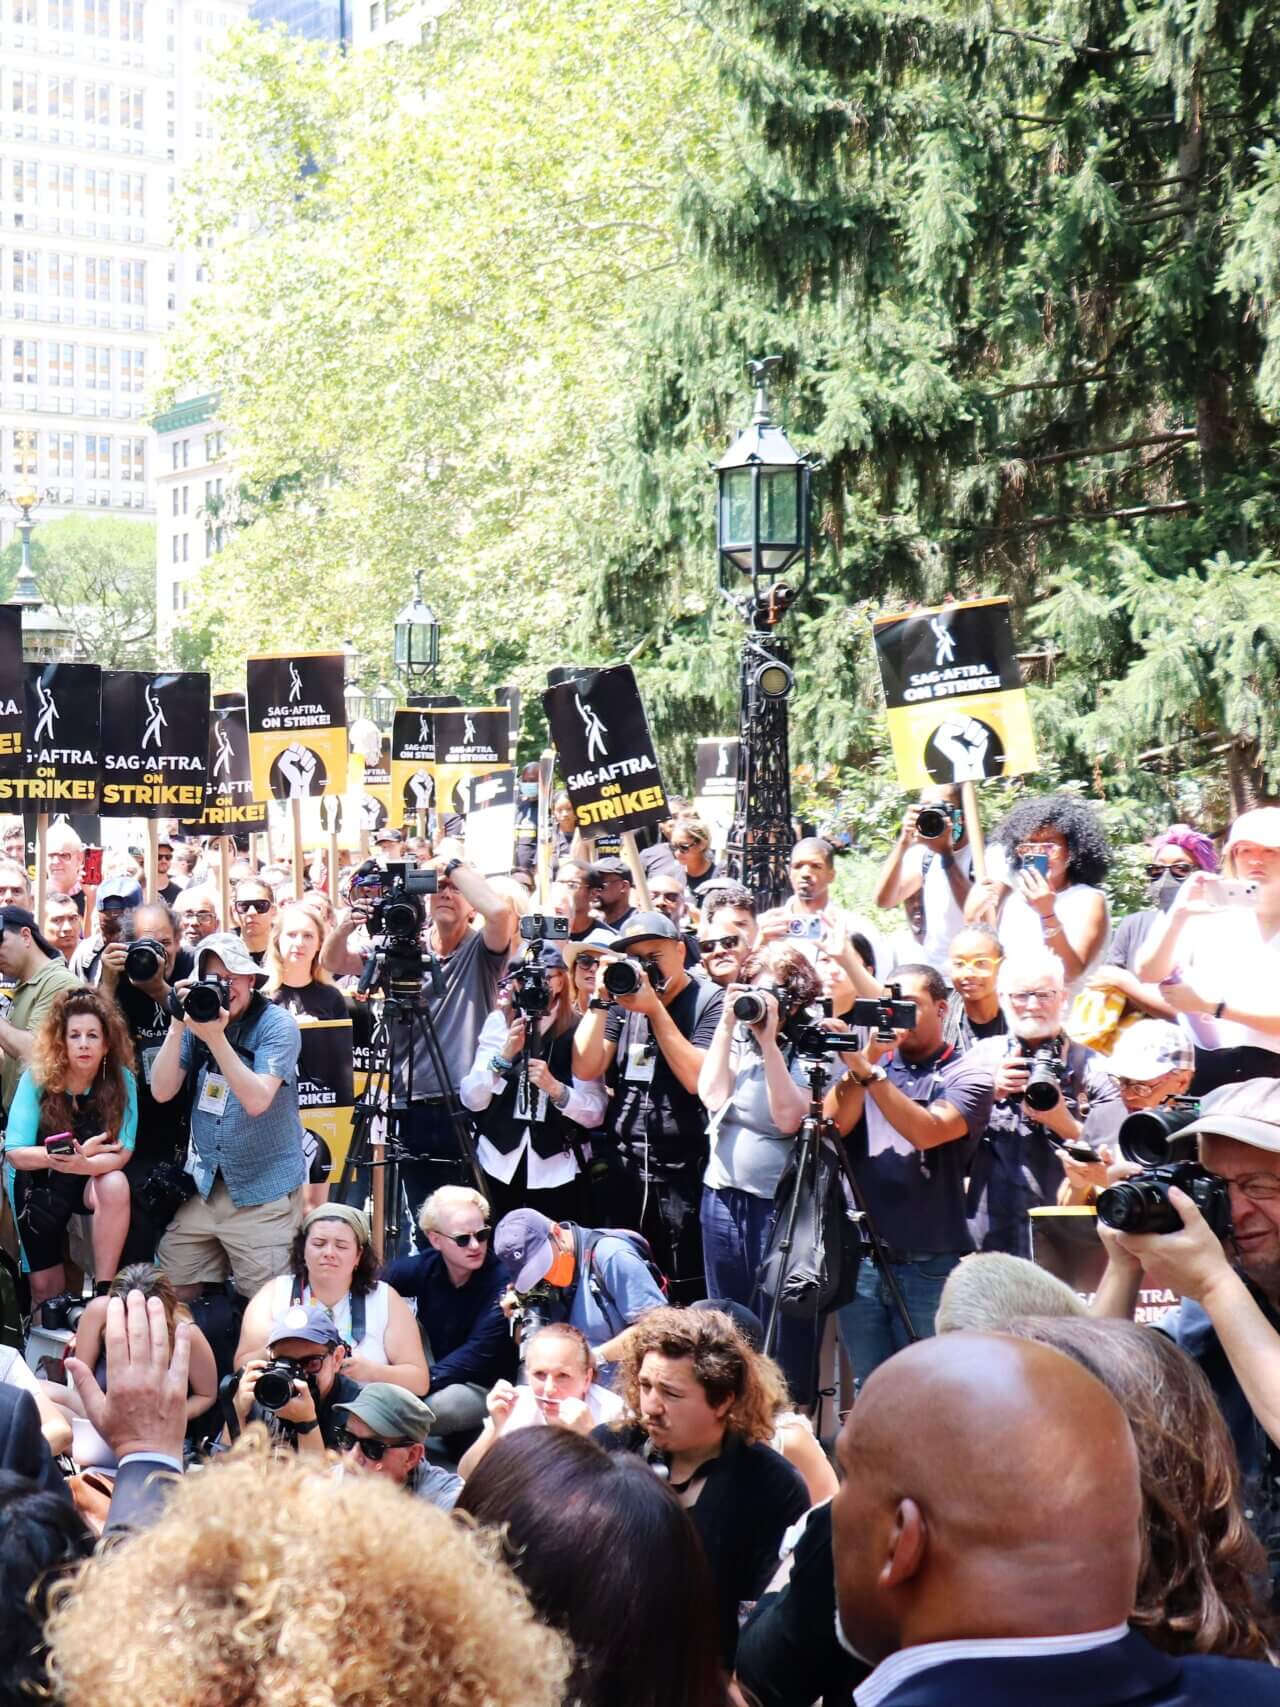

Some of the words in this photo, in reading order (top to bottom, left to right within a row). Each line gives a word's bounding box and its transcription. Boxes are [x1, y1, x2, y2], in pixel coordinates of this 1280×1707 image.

[903, 685, 932, 701] ON
[935, 675, 1001, 696] STRIKE!
[262, 717, 280, 728] ON
[284, 716, 331, 727] STRIKE!
[37, 767, 55, 778] ON
[144, 773, 163, 784] ON
[103, 785, 202, 805] STRIKE!
[601, 784, 620, 797] ON
[216, 797, 232, 806] ON
[576, 785, 665, 826] STRIKE!
